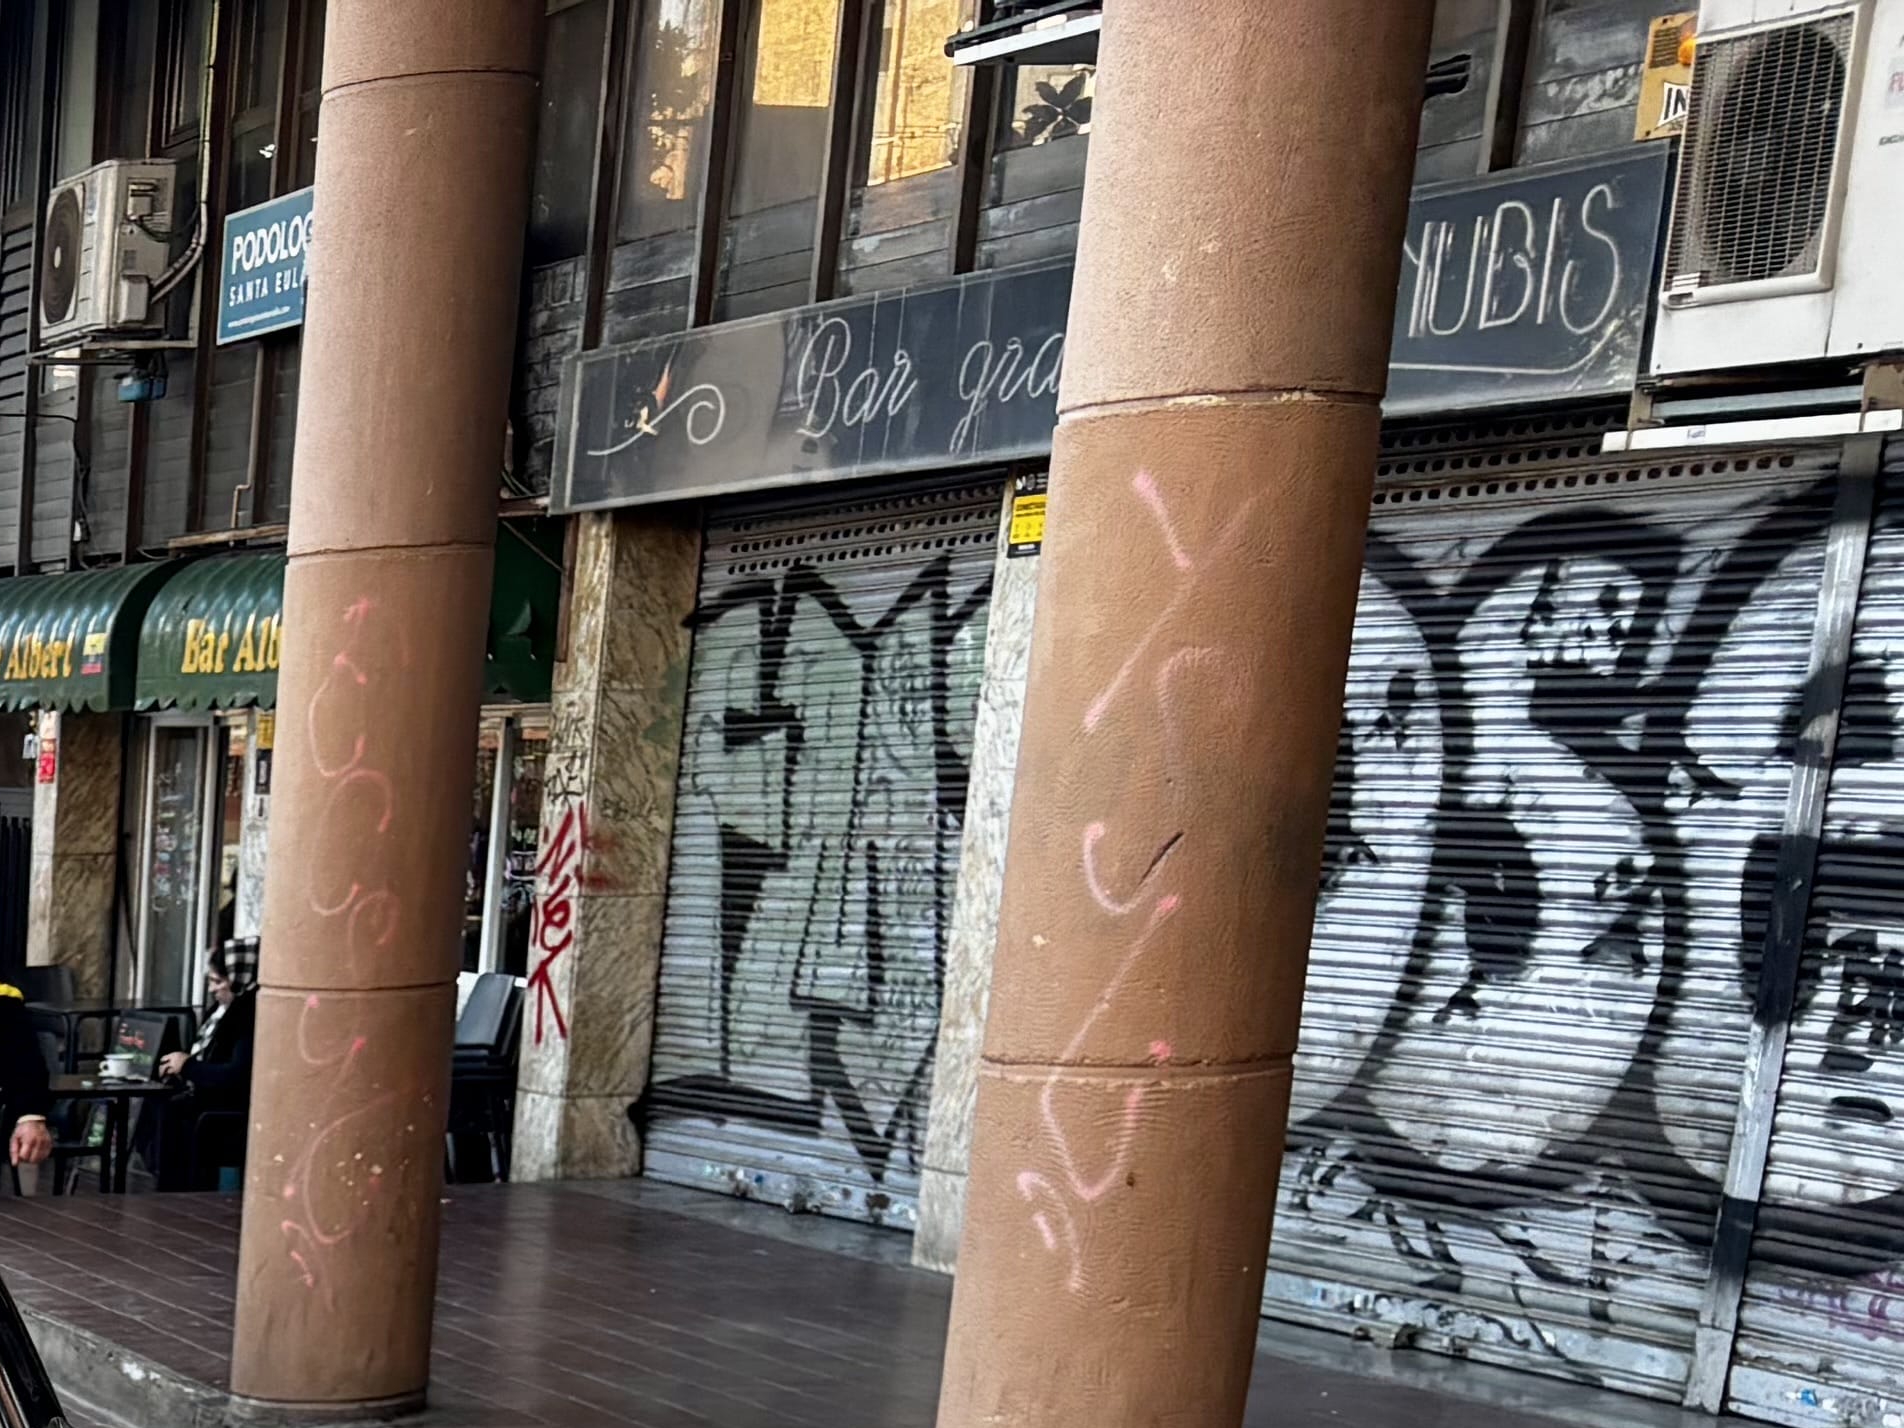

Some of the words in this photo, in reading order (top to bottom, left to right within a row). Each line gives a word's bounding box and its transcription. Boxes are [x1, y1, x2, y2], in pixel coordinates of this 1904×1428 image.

[228, 276, 269, 308] SANTA
[795, 317, 918, 438] Bar
[4, 632, 73, 680] Albert
[181, 618, 229, 674] Bar
